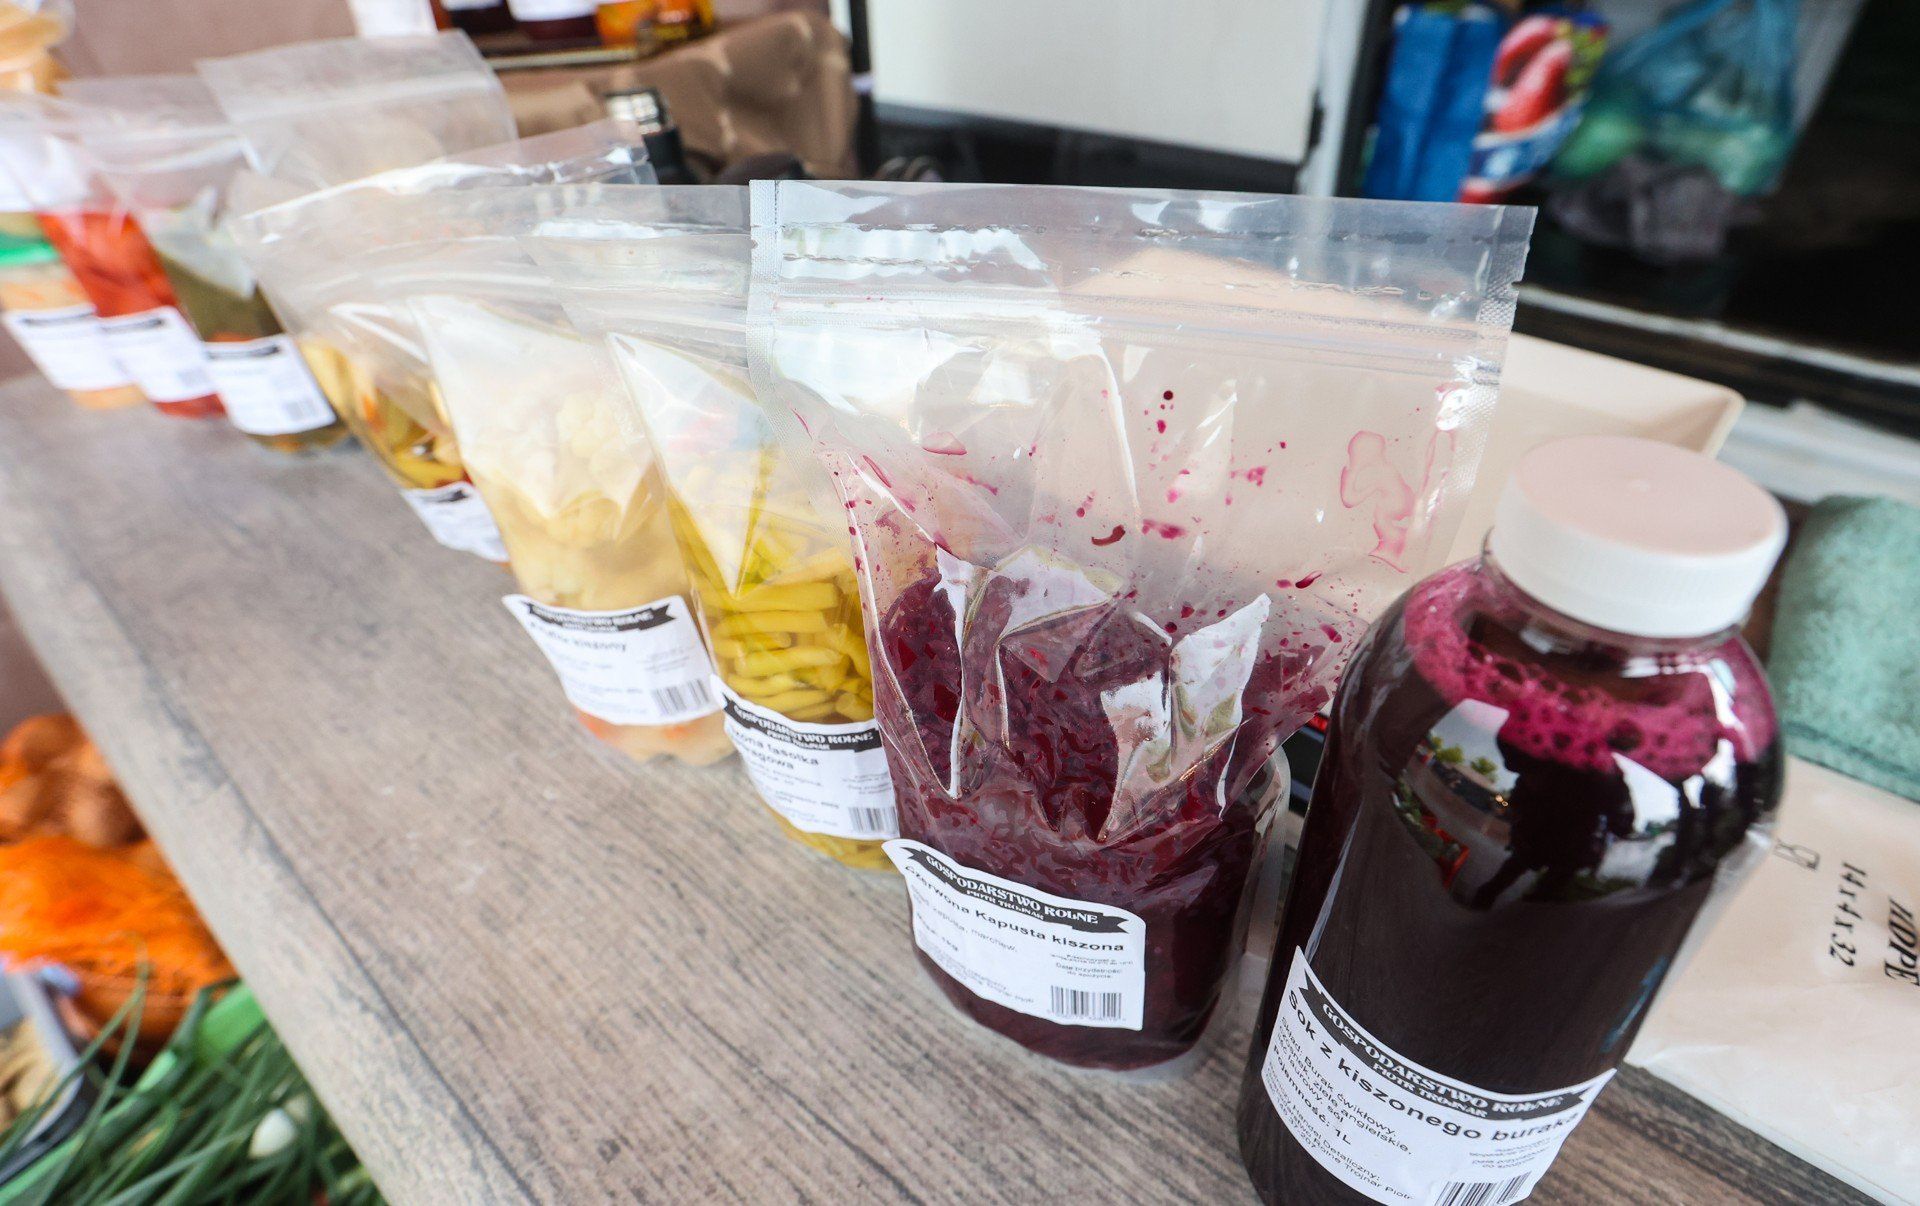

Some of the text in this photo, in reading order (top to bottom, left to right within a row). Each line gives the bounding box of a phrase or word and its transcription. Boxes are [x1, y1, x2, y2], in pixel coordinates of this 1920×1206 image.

[905, 865, 970, 914] Czerwona
[975, 910, 1046, 940] Kapusta
[1052, 935, 1124, 951] kiszona
[926, 855, 1041, 911] GOSPODARSTWO
[1044, 906, 1098, 925] ROLNE
[1274, 1045, 1330, 1127] Pojemność:
[1289, 990, 1578, 1141] Sok z kiszonego buraka
[1305, 1056, 1333, 1091] Burak
[1313, 1081, 1338, 1107] ziele
[1322, 1003, 1564, 1113] GOSPODARSTWO ROLNE
[1373, 1062, 1488, 1117] PIOTR TROJNAR
[1293, 1105, 1322, 1139] Handel
[1323, 1140, 1381, 1180] Detaliczny:
[1344, 1163, 1382, 1188] Trojnar
[1385, 1186, 1414, 1200] Piotr
